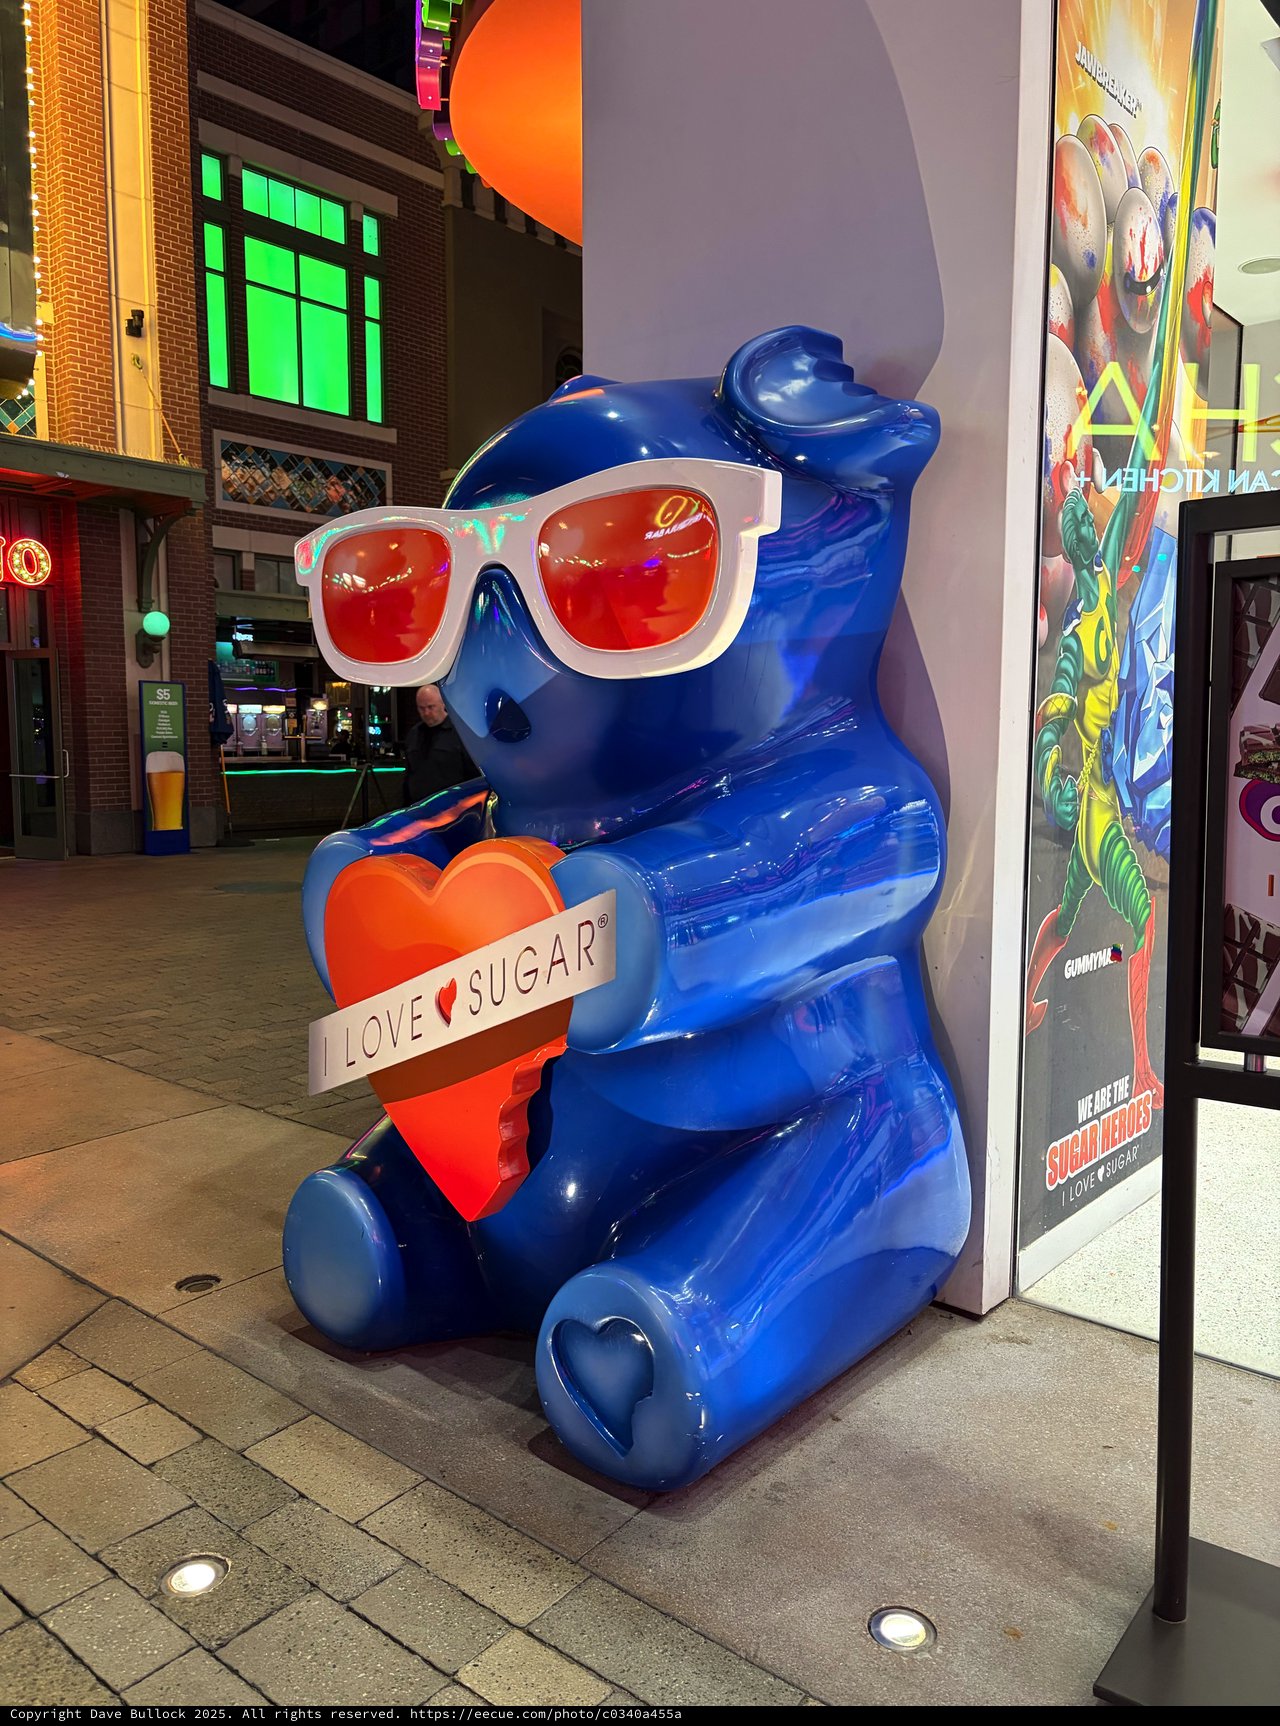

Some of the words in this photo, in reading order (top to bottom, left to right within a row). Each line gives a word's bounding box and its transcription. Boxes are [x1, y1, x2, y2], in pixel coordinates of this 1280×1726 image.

[323, 1037, 328, 1077] I
[346, 995, 423, 1068] LOVE
[1078, 1093, 1093, 1124] WE
[1093, 1083, 1112, 1114] ARE
[1113, 1074, 1130, 1105] THE
[1047, 1120, 1100, 1190] SUGAR
[1100, 1090, 1153, 1158] HEROES
[1069, 1172, 1095, 1202] LOVE
